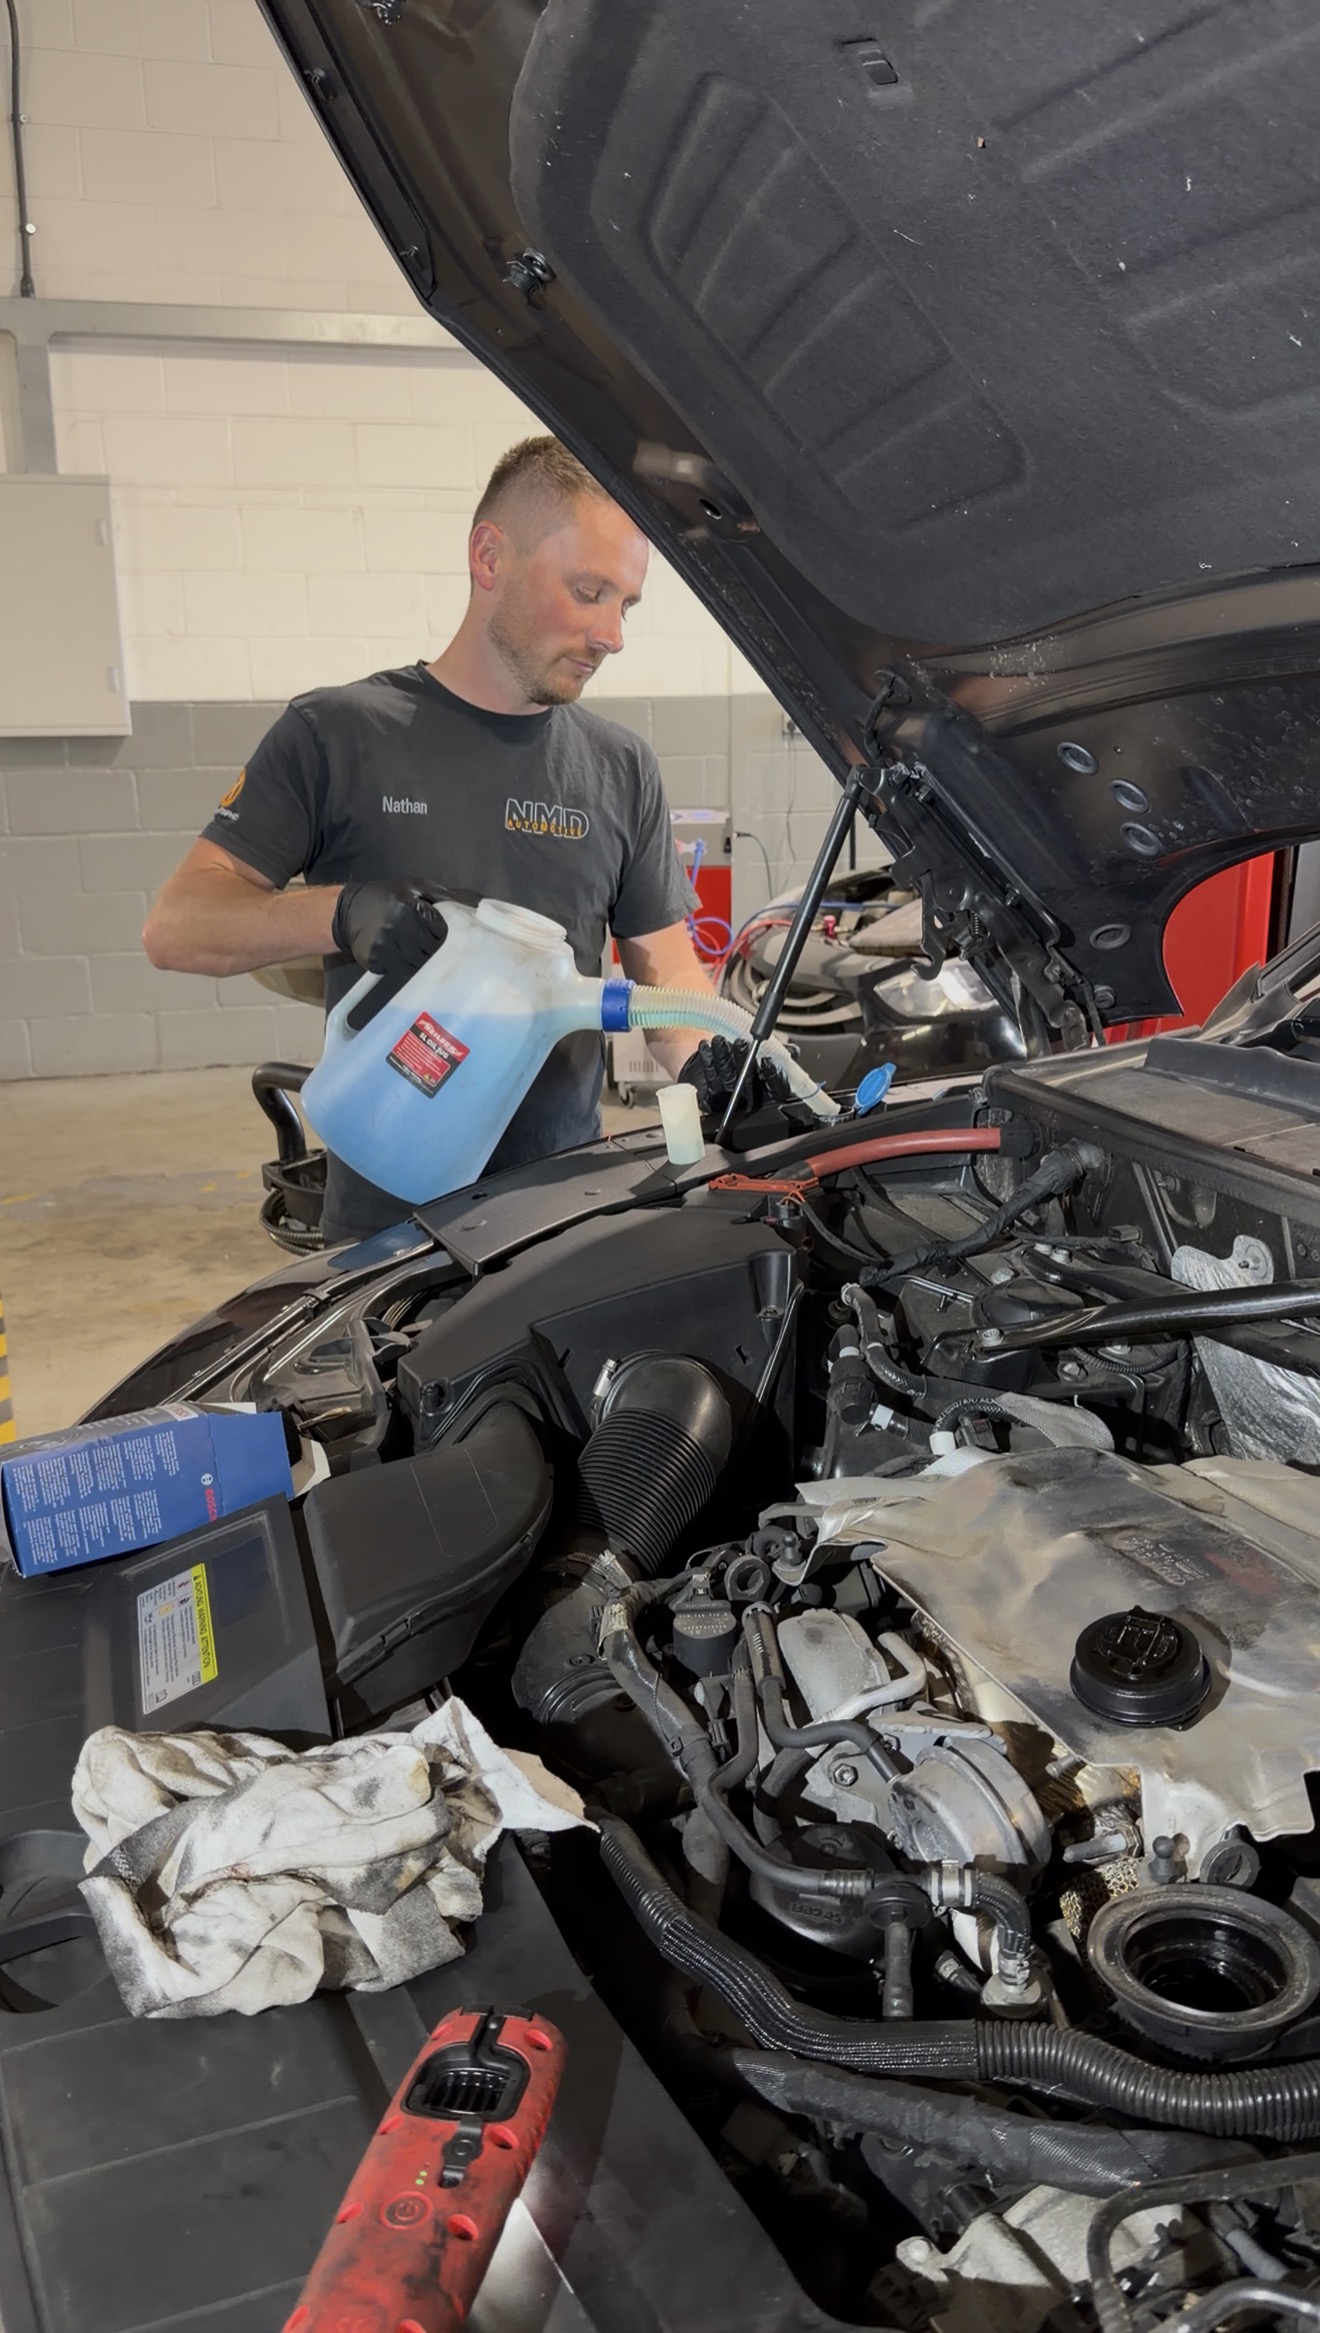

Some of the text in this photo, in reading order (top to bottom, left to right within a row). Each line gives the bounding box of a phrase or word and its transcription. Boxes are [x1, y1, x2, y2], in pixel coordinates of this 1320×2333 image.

[382, 795, 428, 815] Nathan
[505, 798, 589, 839] NMD
[507, 818, 583, 838] AUTOMOTIVE
[426, 1040, 437, 1051] OIL
[435, 1046, 450, 1060] JUG
[197, 1607, 207, 1635] WARNING
[201, 1635, 211, 1669] ATTENTION
